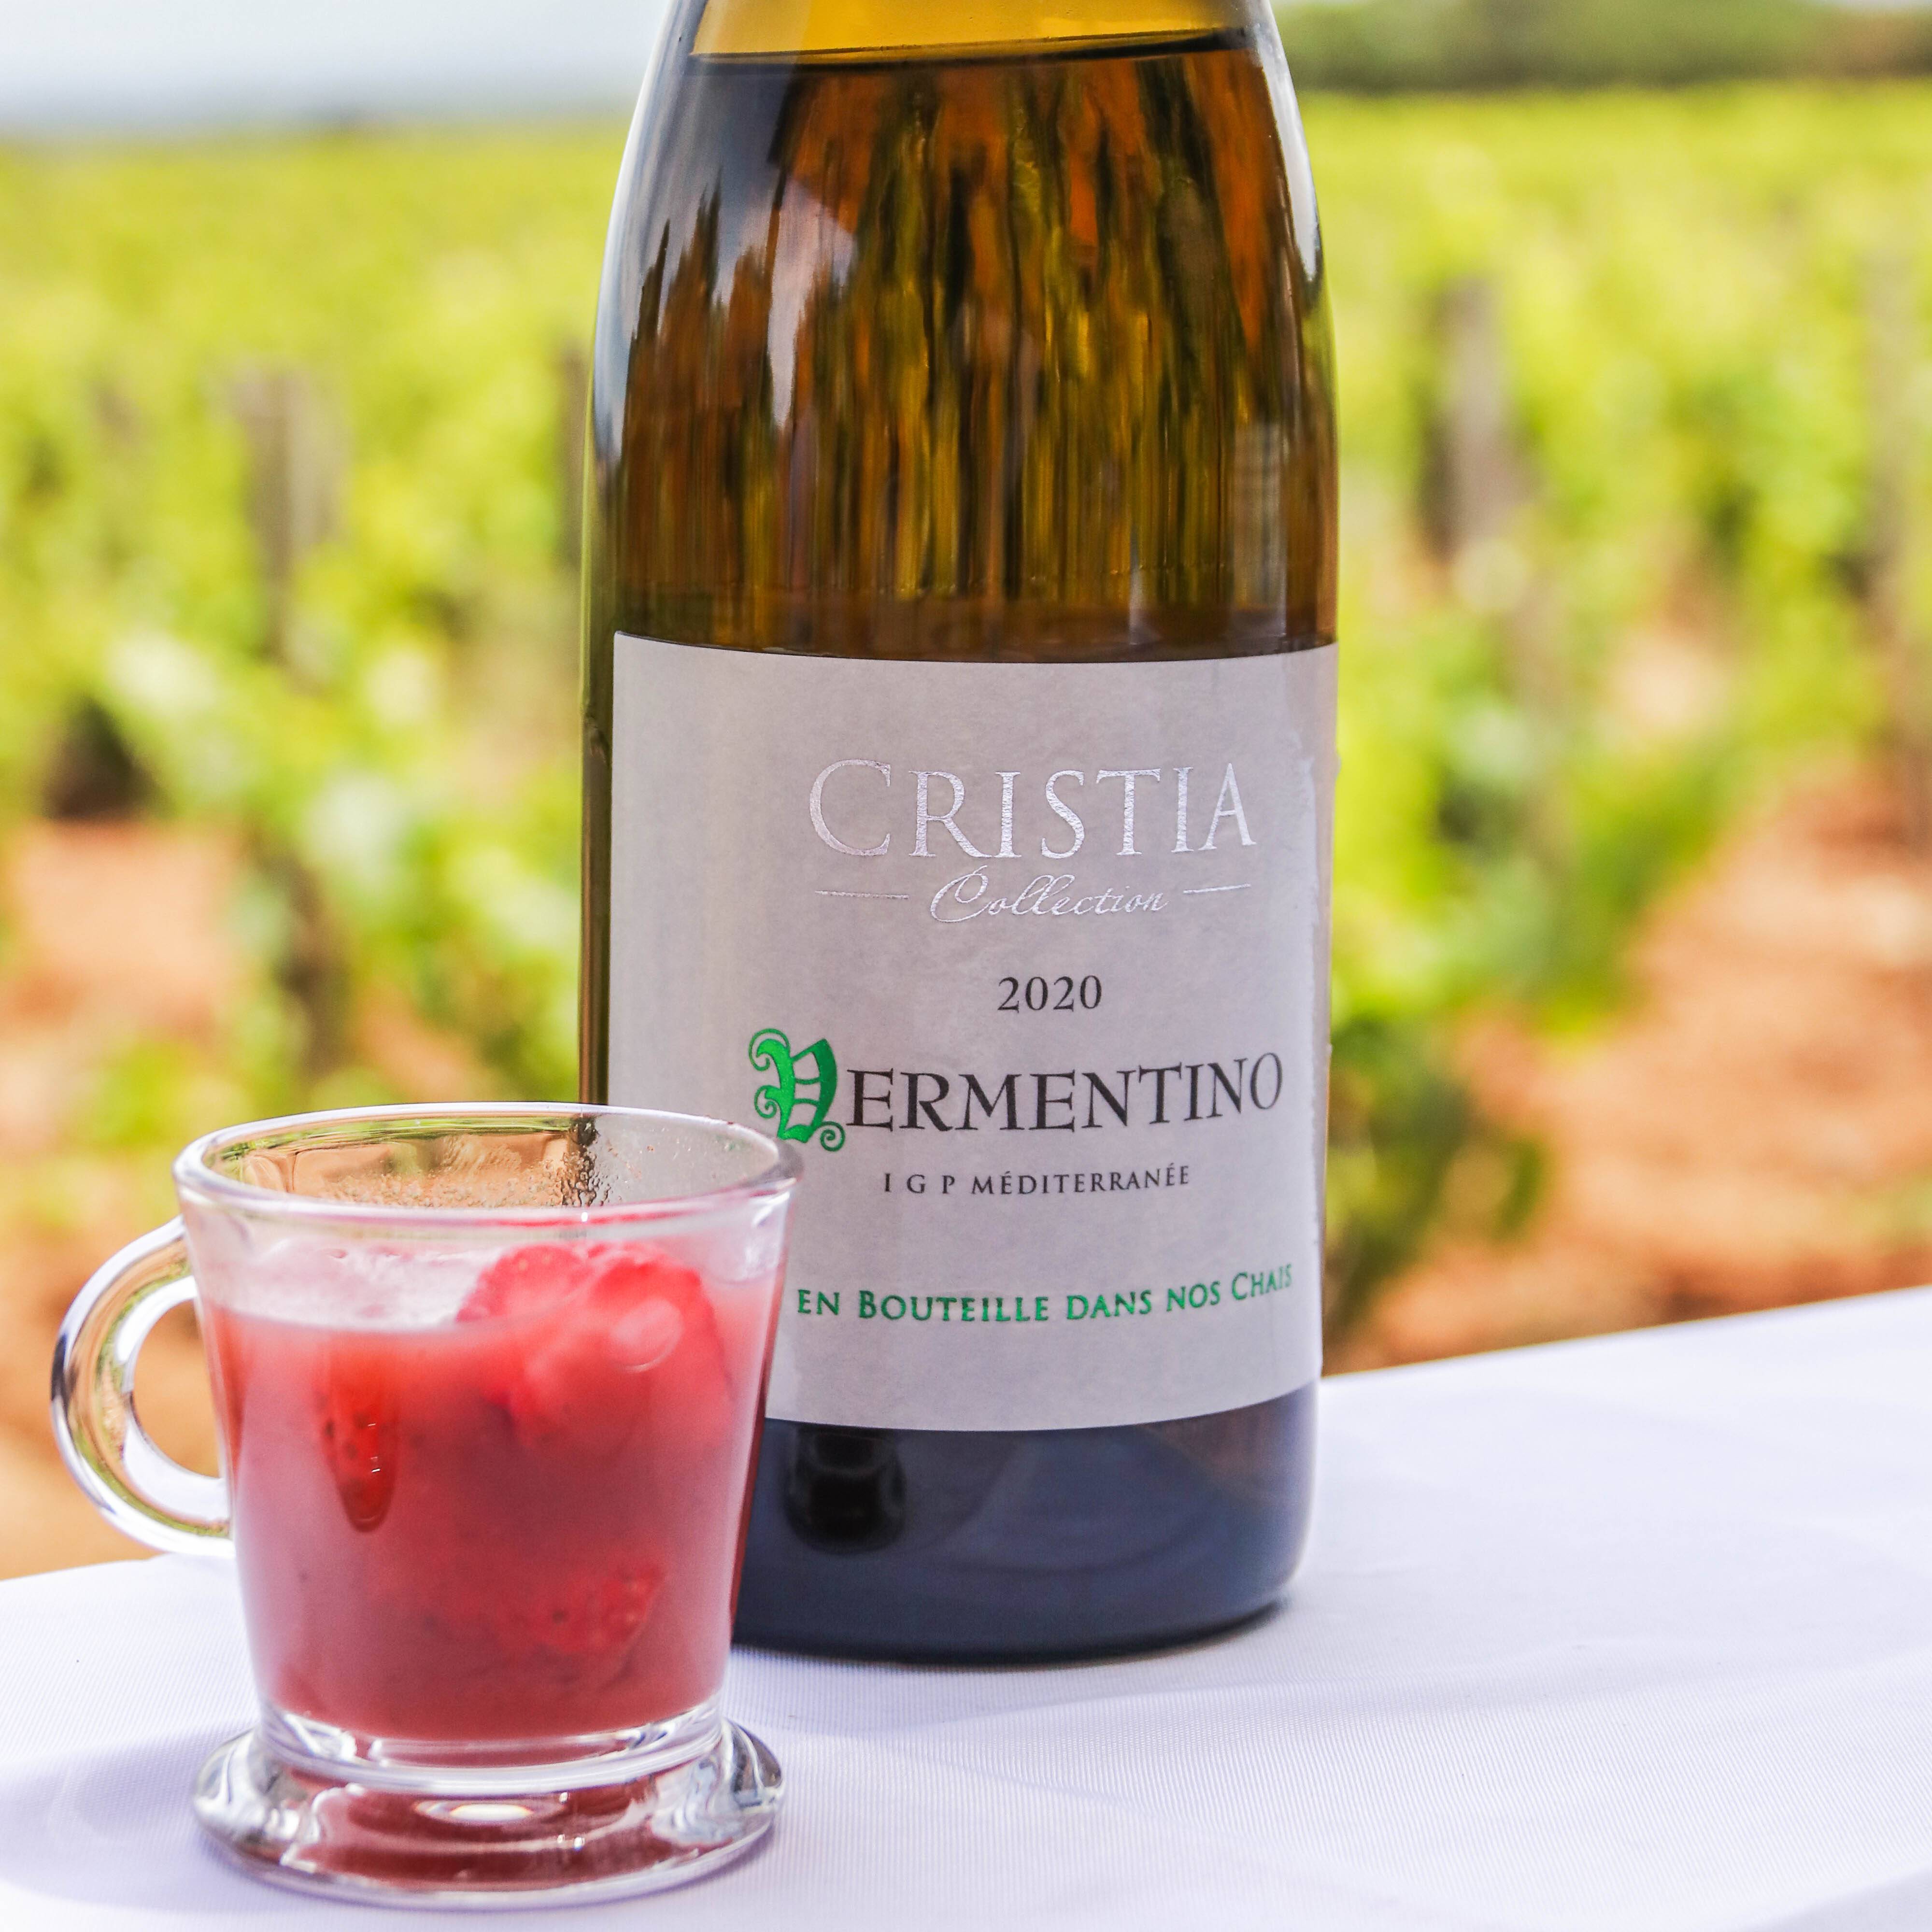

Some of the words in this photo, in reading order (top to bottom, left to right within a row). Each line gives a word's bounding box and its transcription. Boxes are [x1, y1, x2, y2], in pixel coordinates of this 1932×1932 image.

[809, 758, 1257, 859] CRISTIA
[929, 865, 1169, 923] Collection
[997, 974, 1103, 1012] 2020
[749, 1028, 1283, 1151] VERMENTINO
[971, 1163, 1190, 1195] MÉDITERRANÉE
[796, 1289, 840, 1316] EN
[858, 1290, 1049, 1322] BOUTEILLE
[1065, 1290, 1152, 1321] DANS
[1166, 1280, 1221, 1312] NOS
[1232, 1264, 1293, 1300] CHAIS
